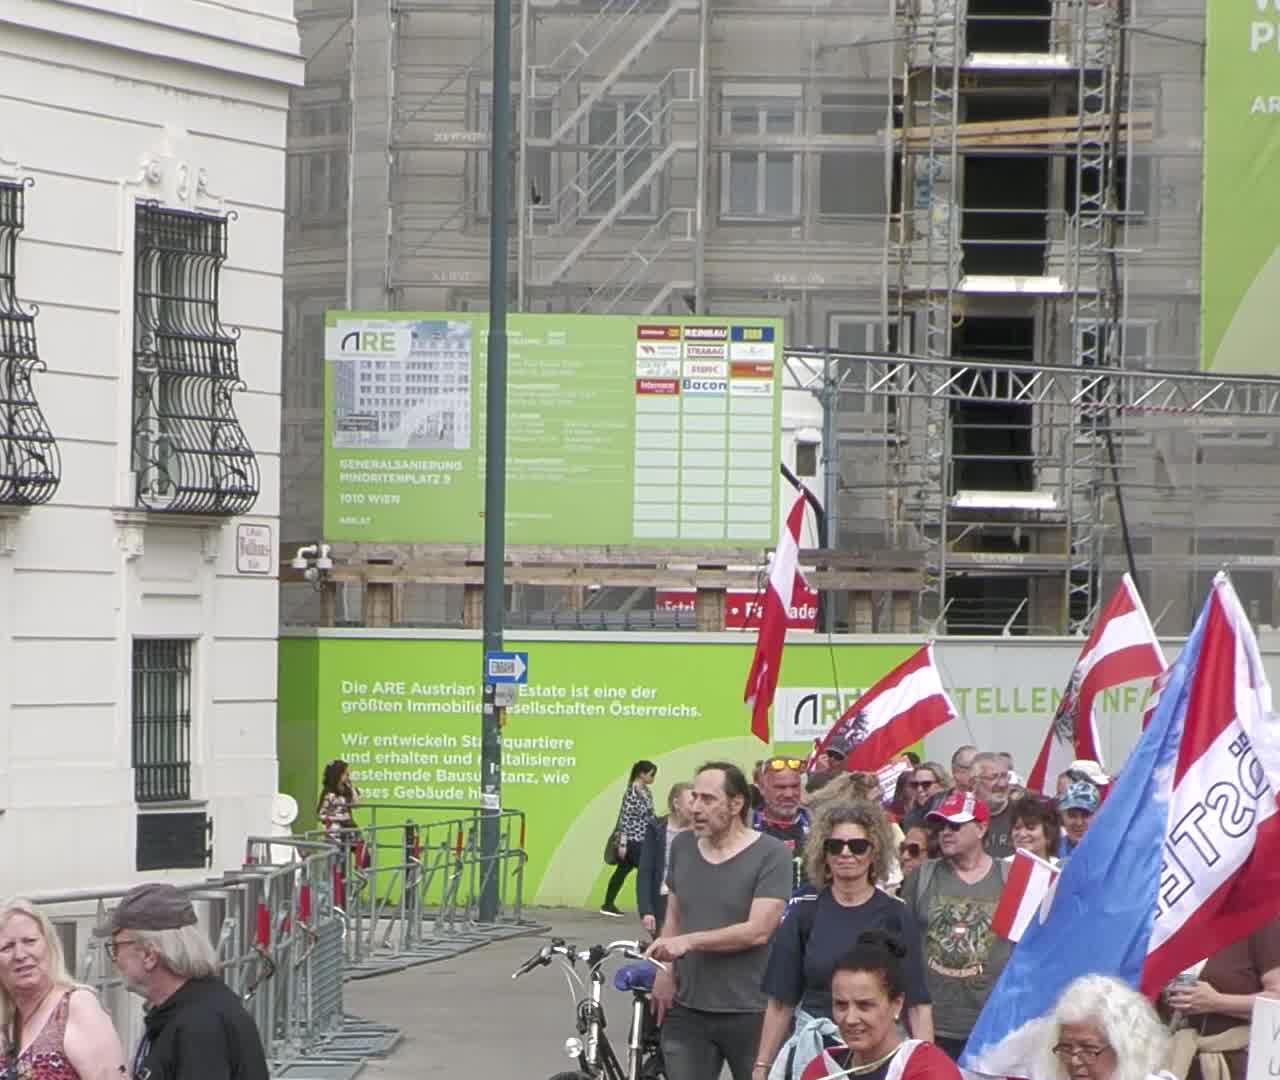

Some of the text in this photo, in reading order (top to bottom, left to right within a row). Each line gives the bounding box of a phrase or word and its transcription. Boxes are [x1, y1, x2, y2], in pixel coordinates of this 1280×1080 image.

[341, 331, 395, 351] ARE
[683, 379, 728, 391] Bacon
[340, 494, 400, 504] 1010 WIEN
[342, 681, 368, 694] Die
[372, 682, 406, 694] ARE
[412, 683, 475, 696] Austrian
[519, 685, 567, 697] Estate
[571, 686, 589, 697] ist
[594, 686, 625, 698] eine
[631, 687, 657, 699] der
[341, 699, 403, 714] größten
[342, 733, 369, 746] Wir
[374, 735, 457, 747] entwickeln
[341, 752, 370, 763] und
[376, 752, 438, 765] erhalten
[444, 752, 473, 765] und
[350, 769, 431, 781] estehende
[543, 772, 570, 784] wie
[394, 786, 464, 800] Gebäude
